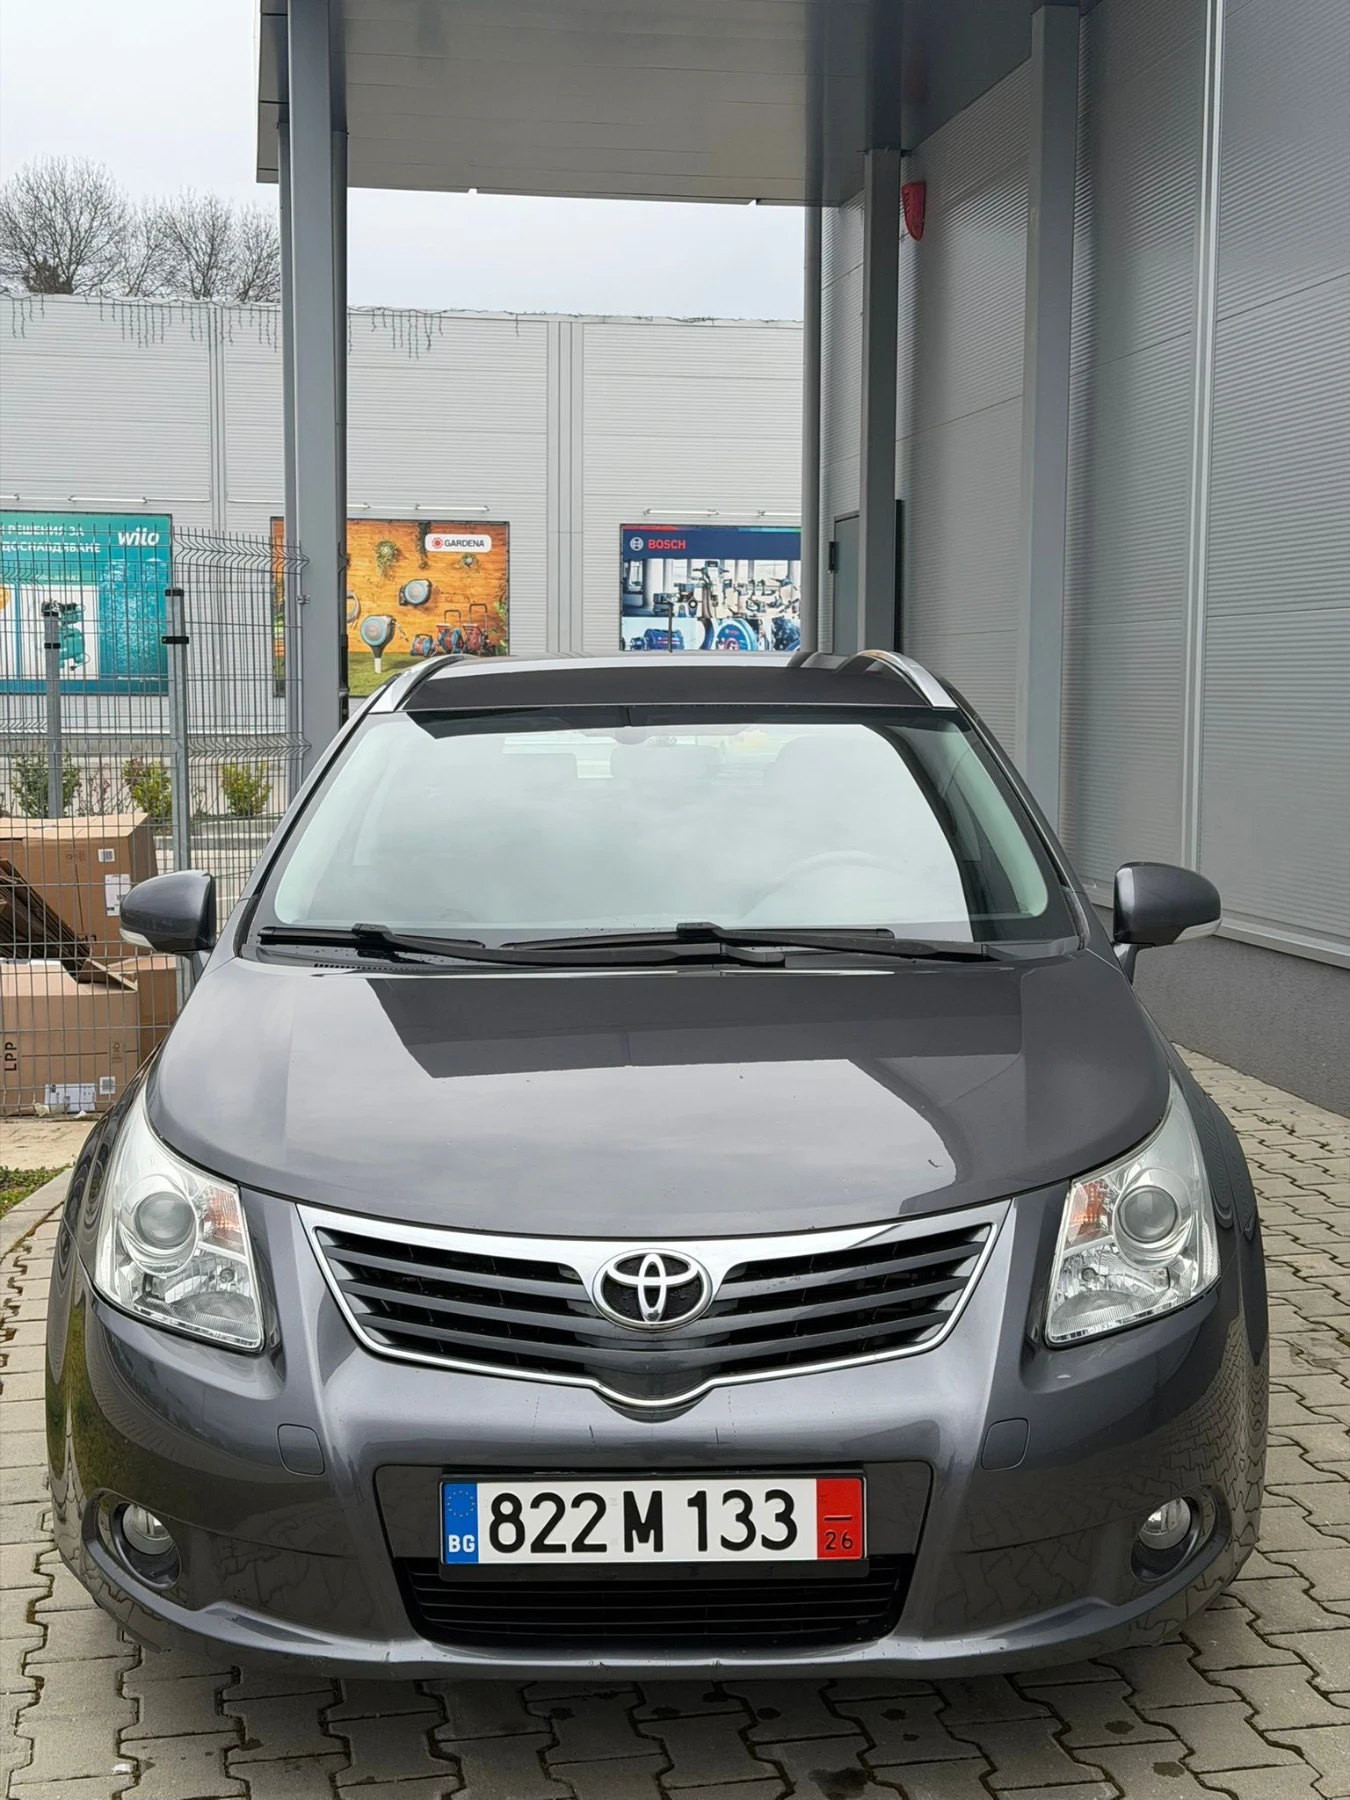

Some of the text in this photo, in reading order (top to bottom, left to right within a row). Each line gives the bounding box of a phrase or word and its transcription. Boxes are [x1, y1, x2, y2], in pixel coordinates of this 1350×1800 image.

[69, 526, 85, 537] ЗА
[118, 527, 160, 546] wilo
[444, 540, 485, 548] GARDENA
[647, 539, 687, 550] BOSCH
[4, 1041, 17, 1072] LPP
[489, 1489, 798, 1553] 822 M 133
[448, 1534, 475, 1553] BG
[824, 1531, 853, 1551] 26
